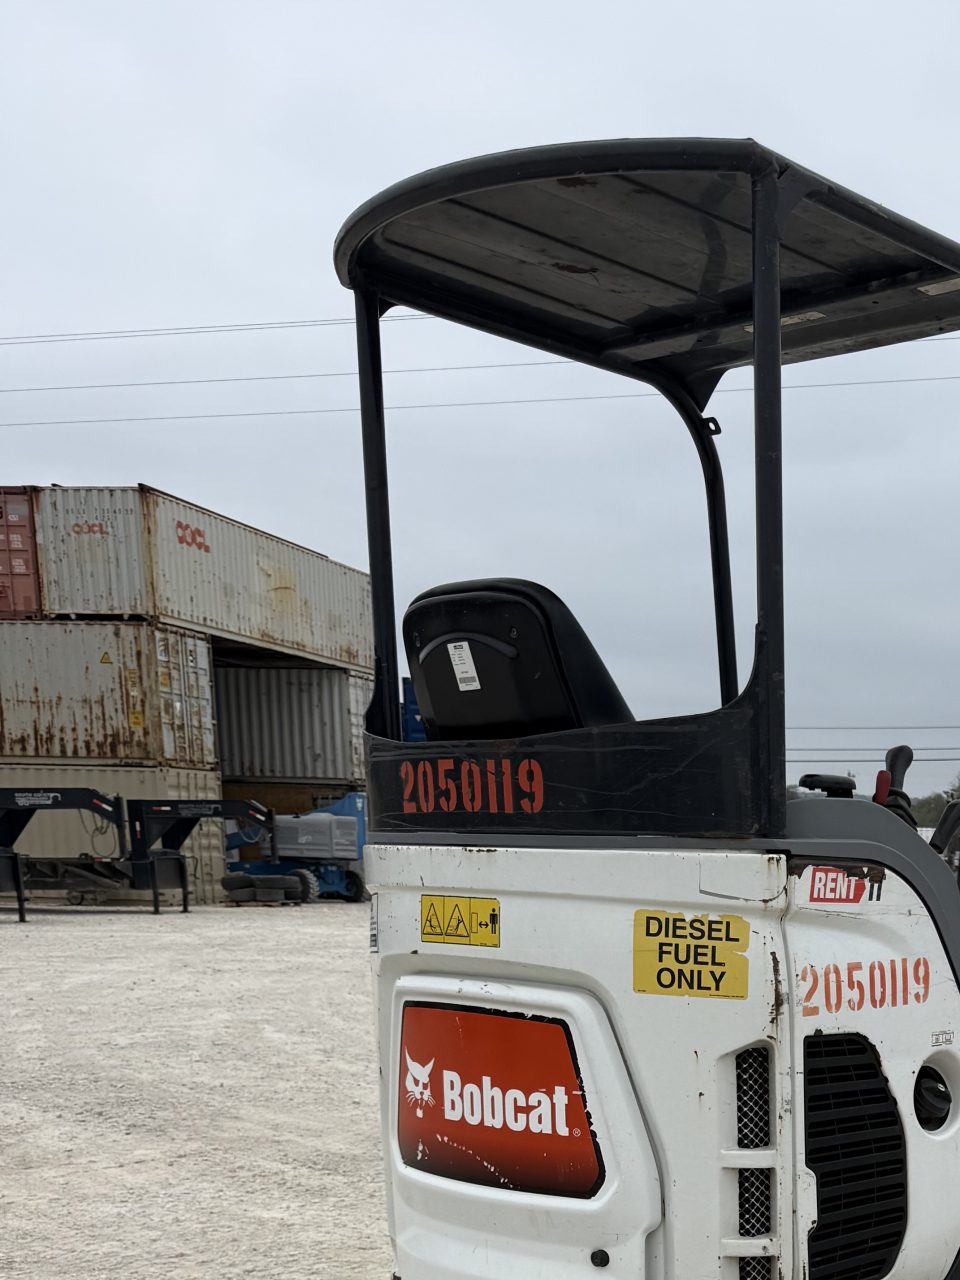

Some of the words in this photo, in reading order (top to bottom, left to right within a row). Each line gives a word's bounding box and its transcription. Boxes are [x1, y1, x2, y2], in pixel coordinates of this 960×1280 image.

[400, 759, 544, 813] 2050119
[813, 871, 859, 900] RENT
[645, 916, 740, 942] DIESEL
[658, 942, 726, 967] FUEL
[656, 967, 726, 992] ONLY
[800, 957, 930, 1017] 2050119
[442, 1069, 570, 1137] Bobcat
